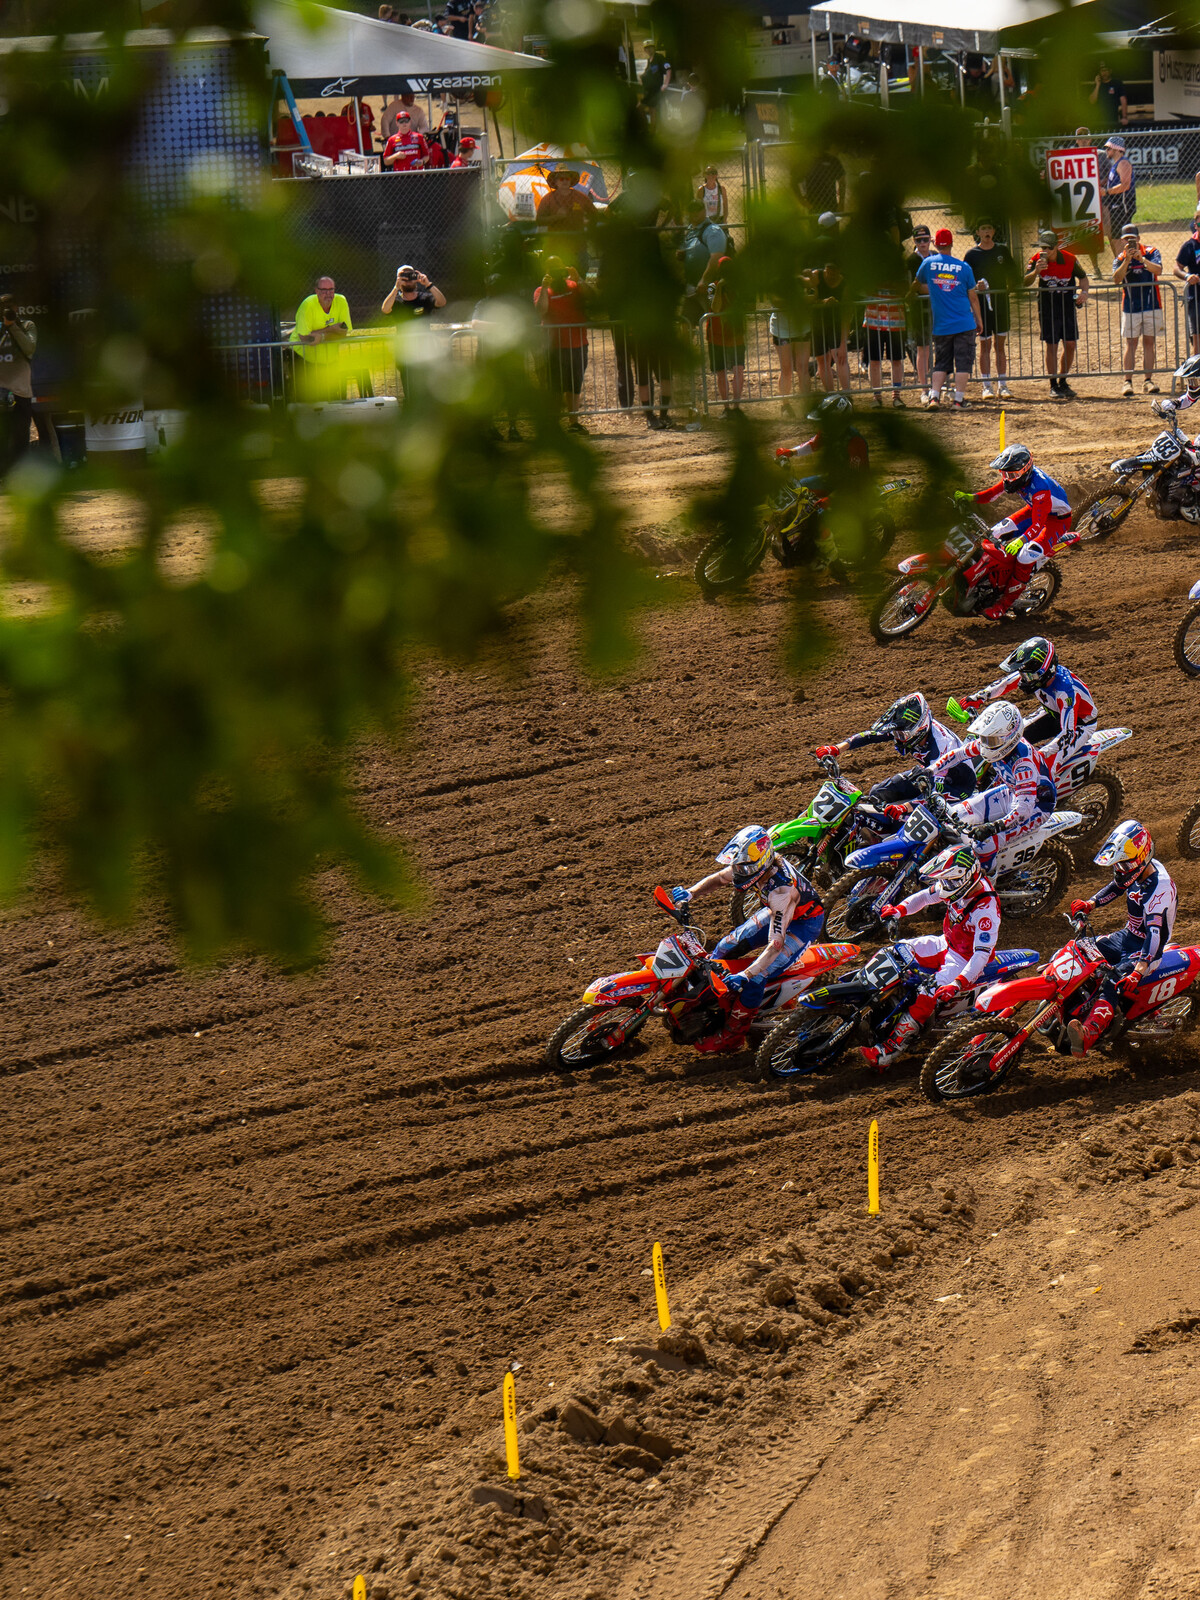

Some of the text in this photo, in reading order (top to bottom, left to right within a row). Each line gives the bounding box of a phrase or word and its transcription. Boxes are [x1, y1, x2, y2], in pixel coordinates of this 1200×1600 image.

[433, 75, 502, 91] seaspan
[1050, 158, 1096, 180] GATE
[1054, 181, 1096, 223] 12
[930, 262, 962, 273] STAFF
[1153, 435, 1179, 459] 483
[1071, 759, 1091, 788] 9
[813, 791, 847, 822] 21
[903, 810, 935, 842] 36
[1012, 845, 1036, 868] 36
[877, 879, 901, 909] DUNLOP
[773, 911, 784, 935] THOR
[978, 917, 992, 930] 68
[864, 954, 898, 989] 14
[1052, 951, 1083, 982] 18
[1158, 967, 1186, 978] LAWRENCE
[1147, 977, 1178, 1004] 18
[828, 1021, 854, 1046] DUNLOP
[995, 1041, 1021, 1068] DUNLOP
